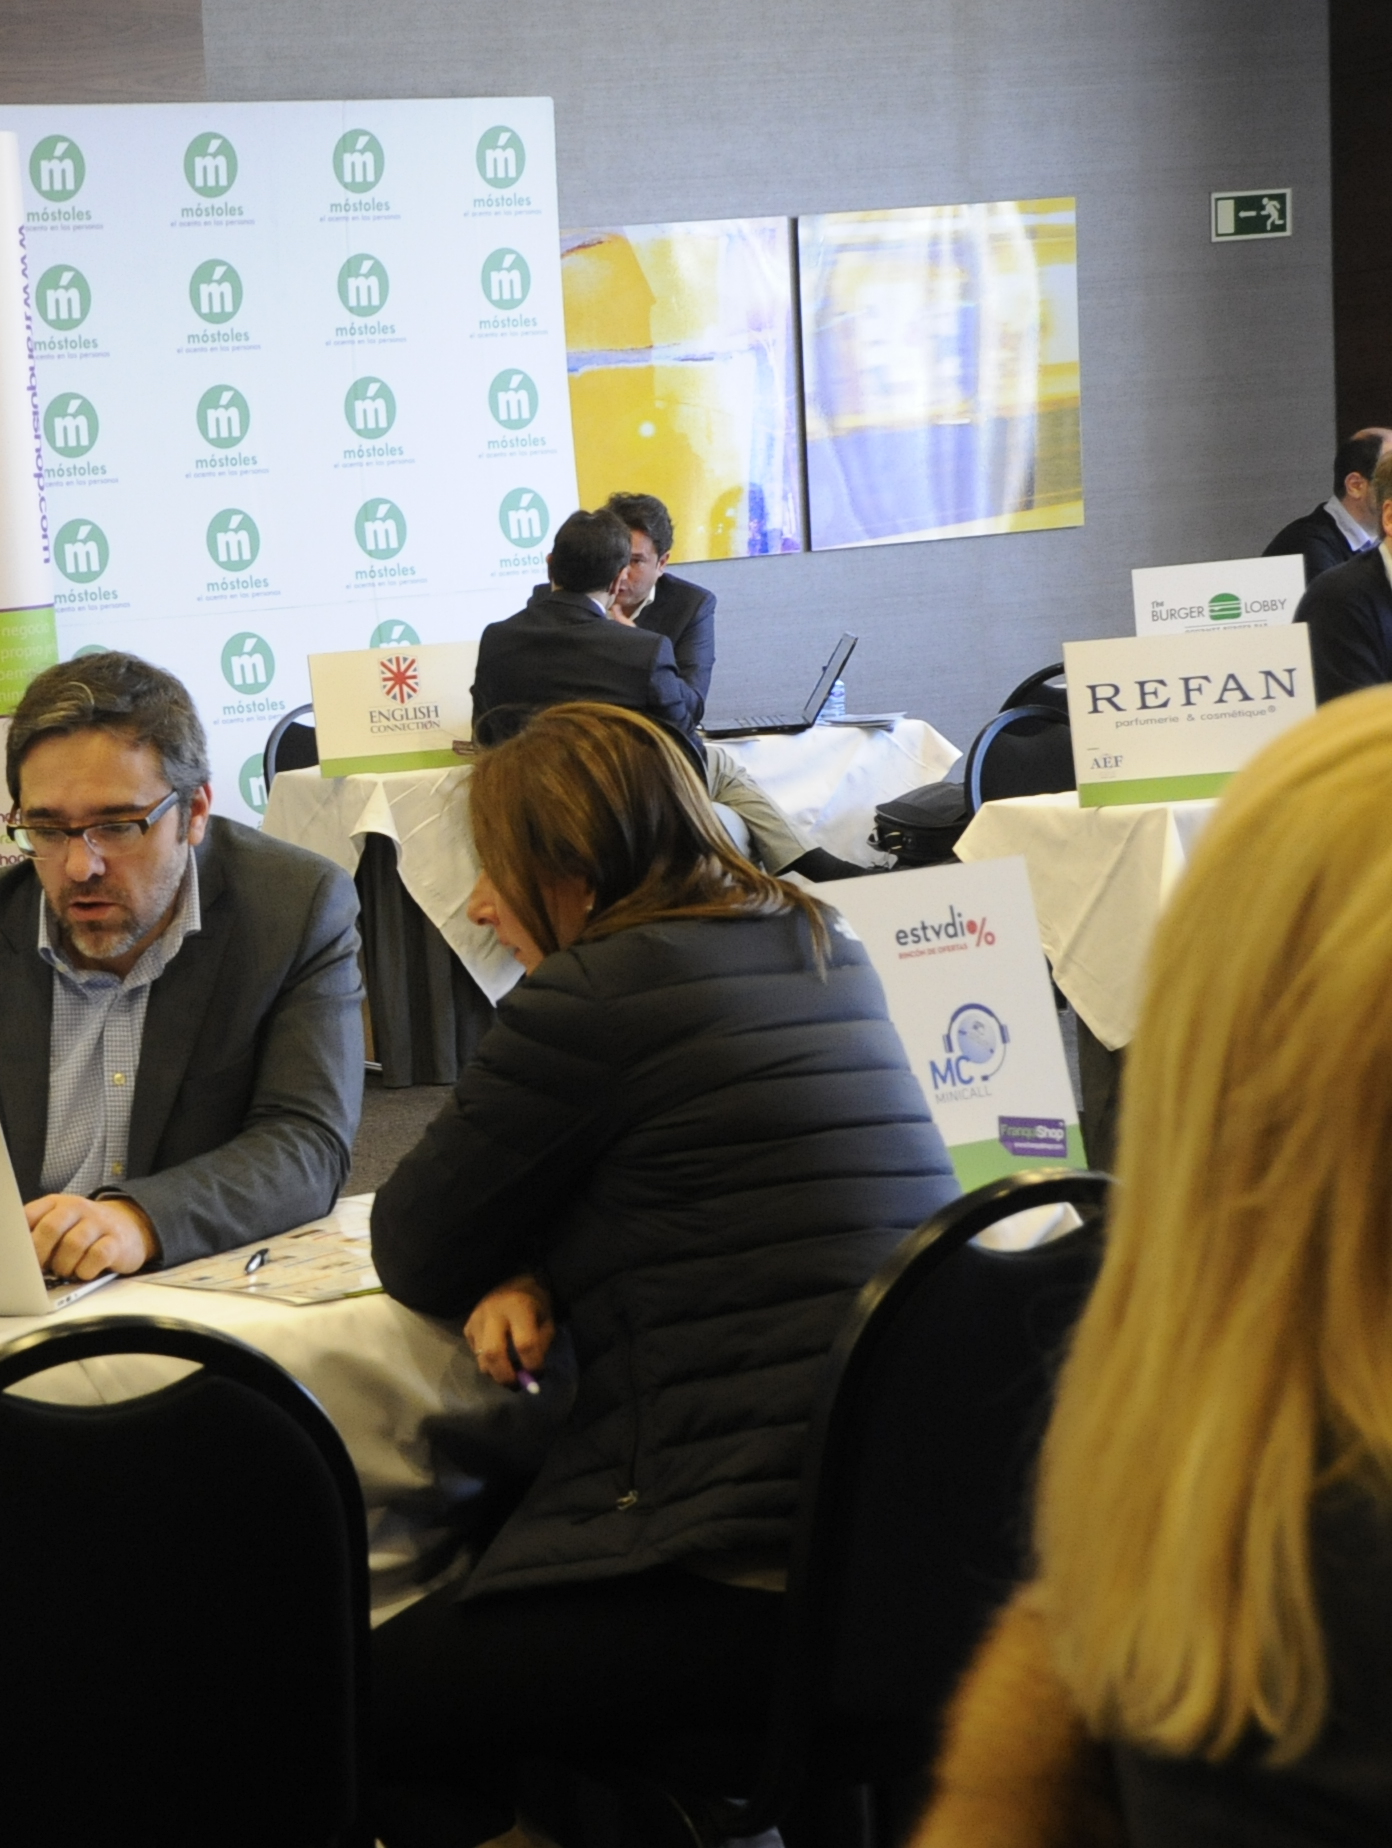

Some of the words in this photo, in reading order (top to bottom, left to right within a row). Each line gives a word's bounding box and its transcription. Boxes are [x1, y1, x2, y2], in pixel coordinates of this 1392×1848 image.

[330, 197, 391, 213] móstoles
[473, 192, 532, 208] móstoles
[26, 206, 92, 222] móstoles
[181, 201, 244, 218] móstoles
[335, 320, 396, 337] móstoles
[479, 313, 538, 330] móstoles
[34, 334, 98, 350] móstoles
[187, 327, 250, 344] móstoles
[488, 433, 546, 450] móstoles
[343, 442, 404, 459] móstoles
[195, 452, 258, 469] móstoles
[44, 461, 108, 478] móstoles
[500, 551, 544, 568] móstol
[355, 562, 416, 580] móstoles
[207, 574, 269, 592] móstoles
[54, 586, 118, 604] móstoles
[1151, 606, 1205, 622] BURGER
[1244, 599, 1287, 614] LOBBY
[1086, 668, 1297, 714] REFAN
[223, 697, 286, 715] móstoles
[369, 704, 440, 724] ENGLISH
[370, 720, 441, 734] CONNECTION
[1115, 716, 1179, 728] parfumerie
[1186, 714, 1194, 722] &
[1090, 755, 1124, 770] AEF
[929, 1055, 974, 1090] MC
